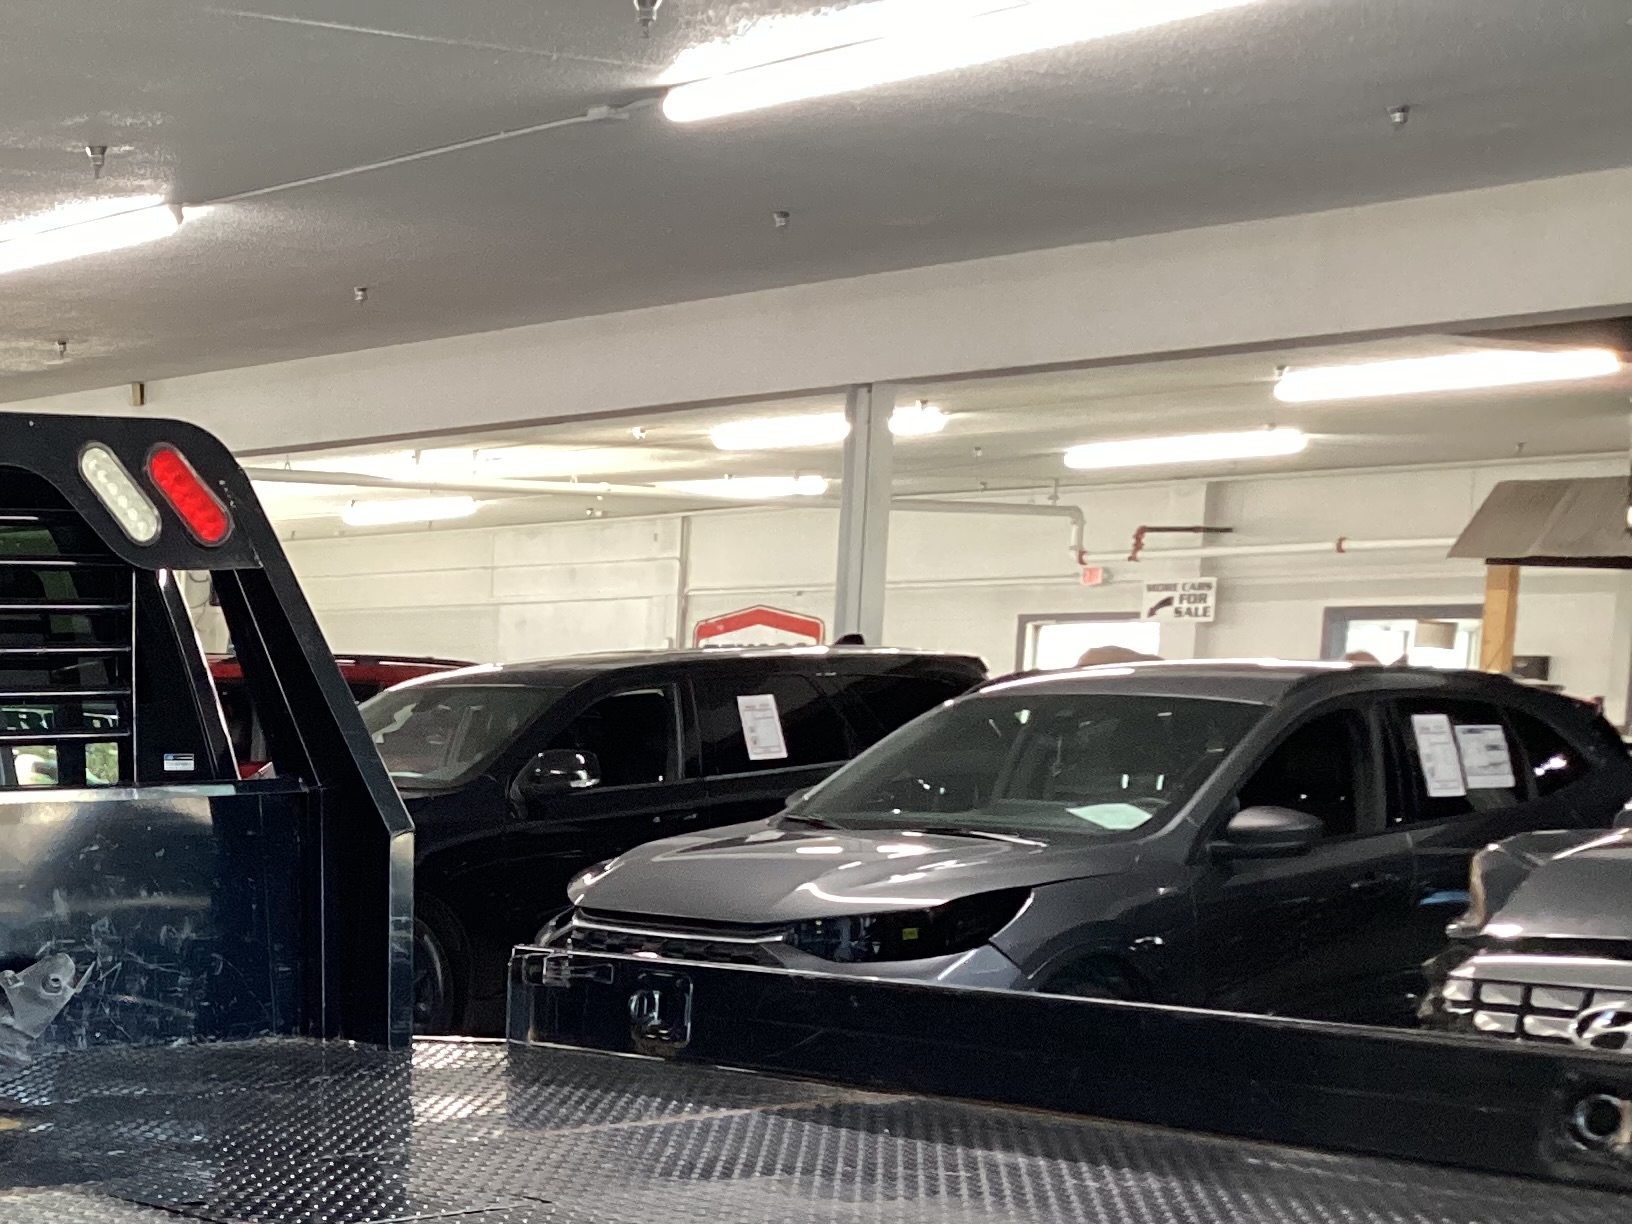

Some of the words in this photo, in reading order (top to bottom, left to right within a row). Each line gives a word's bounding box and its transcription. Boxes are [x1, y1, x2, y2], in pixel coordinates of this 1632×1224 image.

[1181, 582, 1213, 592] CARS
[1178, 593, 1208, 605] FOR
[1173, 606, 1212, 618] SALE
